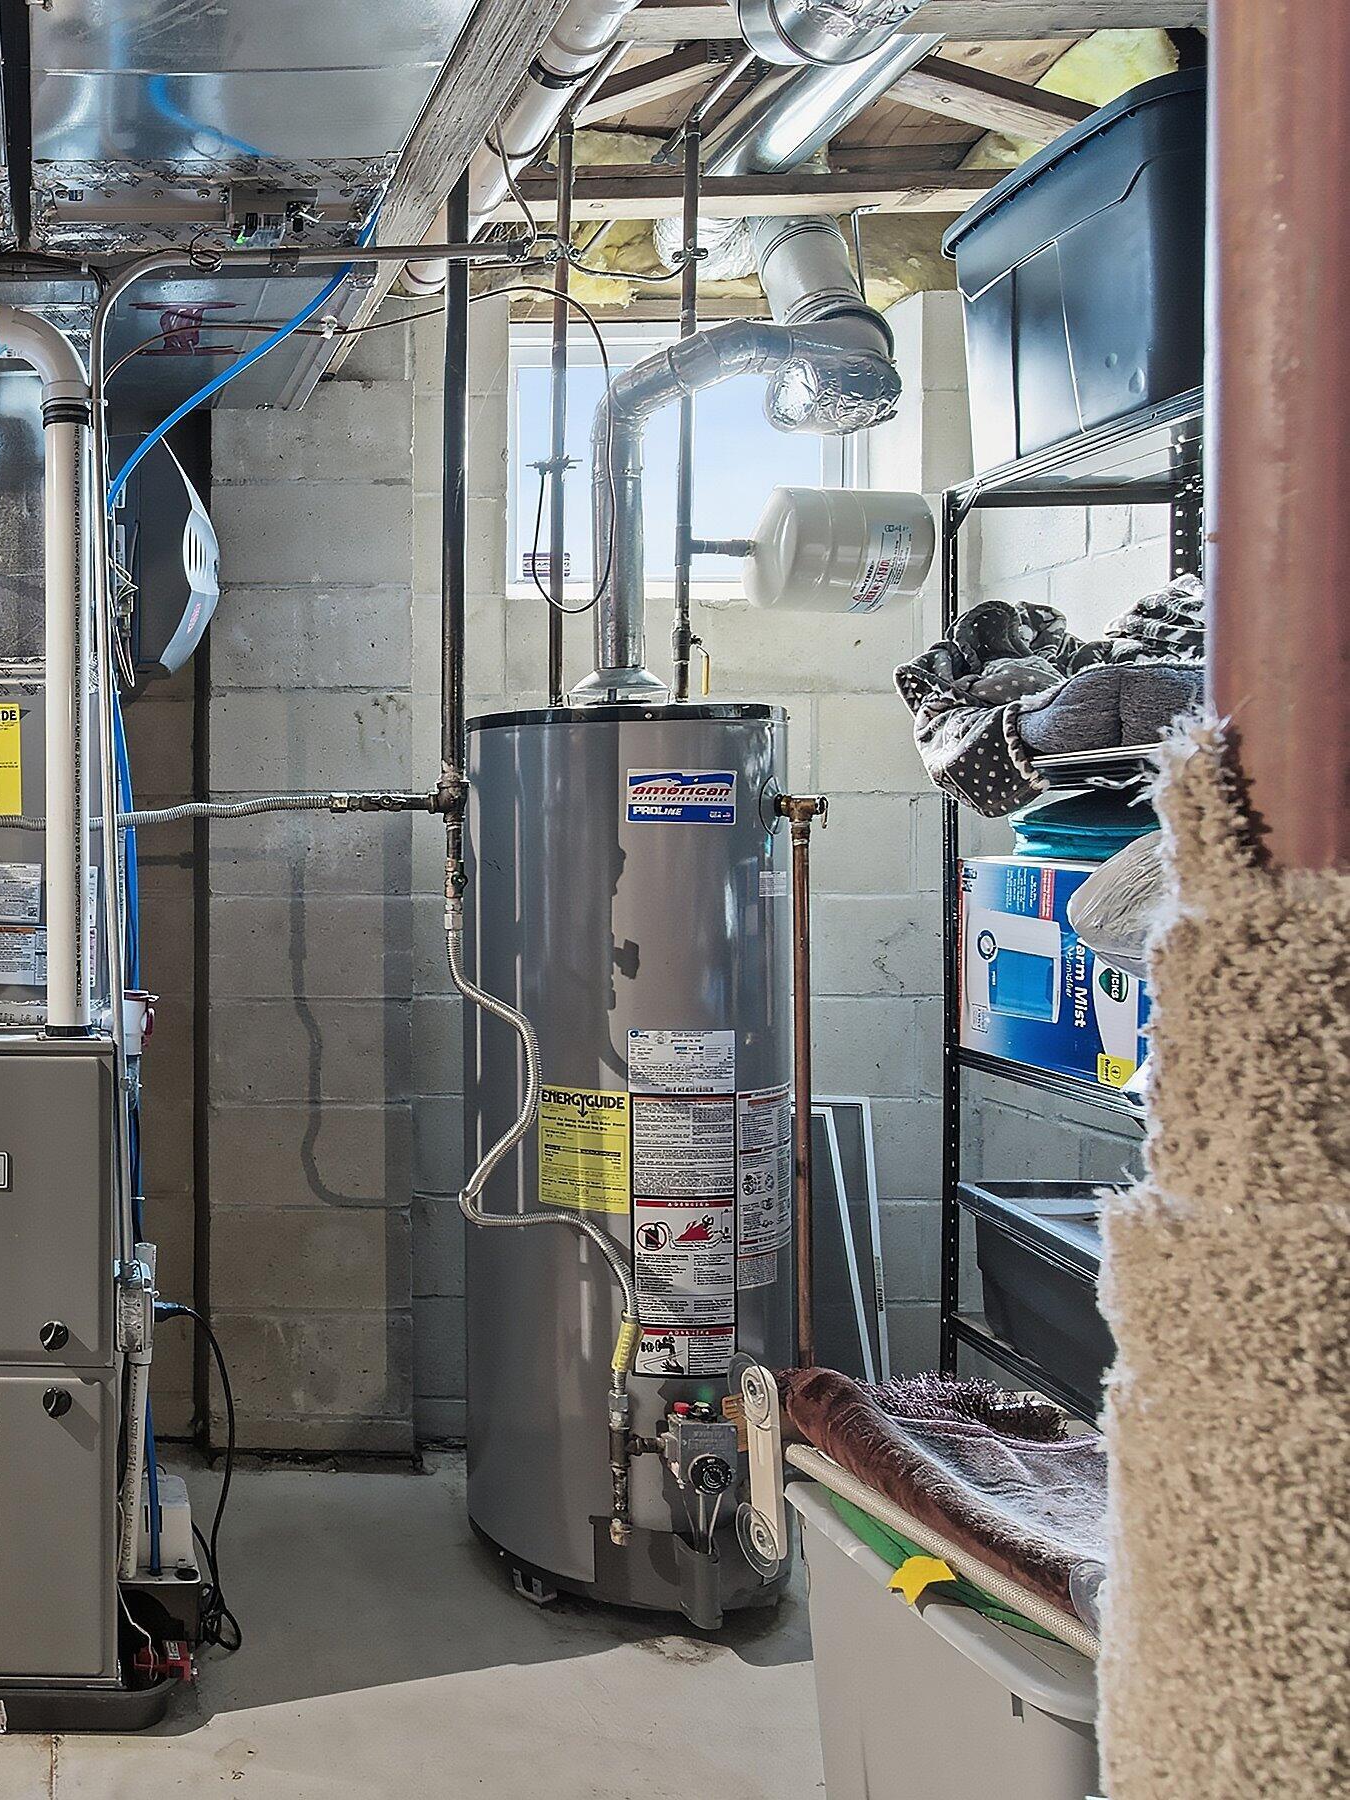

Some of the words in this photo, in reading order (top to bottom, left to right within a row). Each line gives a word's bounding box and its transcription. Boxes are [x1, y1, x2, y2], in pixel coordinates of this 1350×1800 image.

[632, 786, 732, 796] american
[632, 806, 683, 816] PROLINE
[1074, 986, 1088, 1028] Mist
[541, 1089, 626, 1111] ENERGYGUIDE
